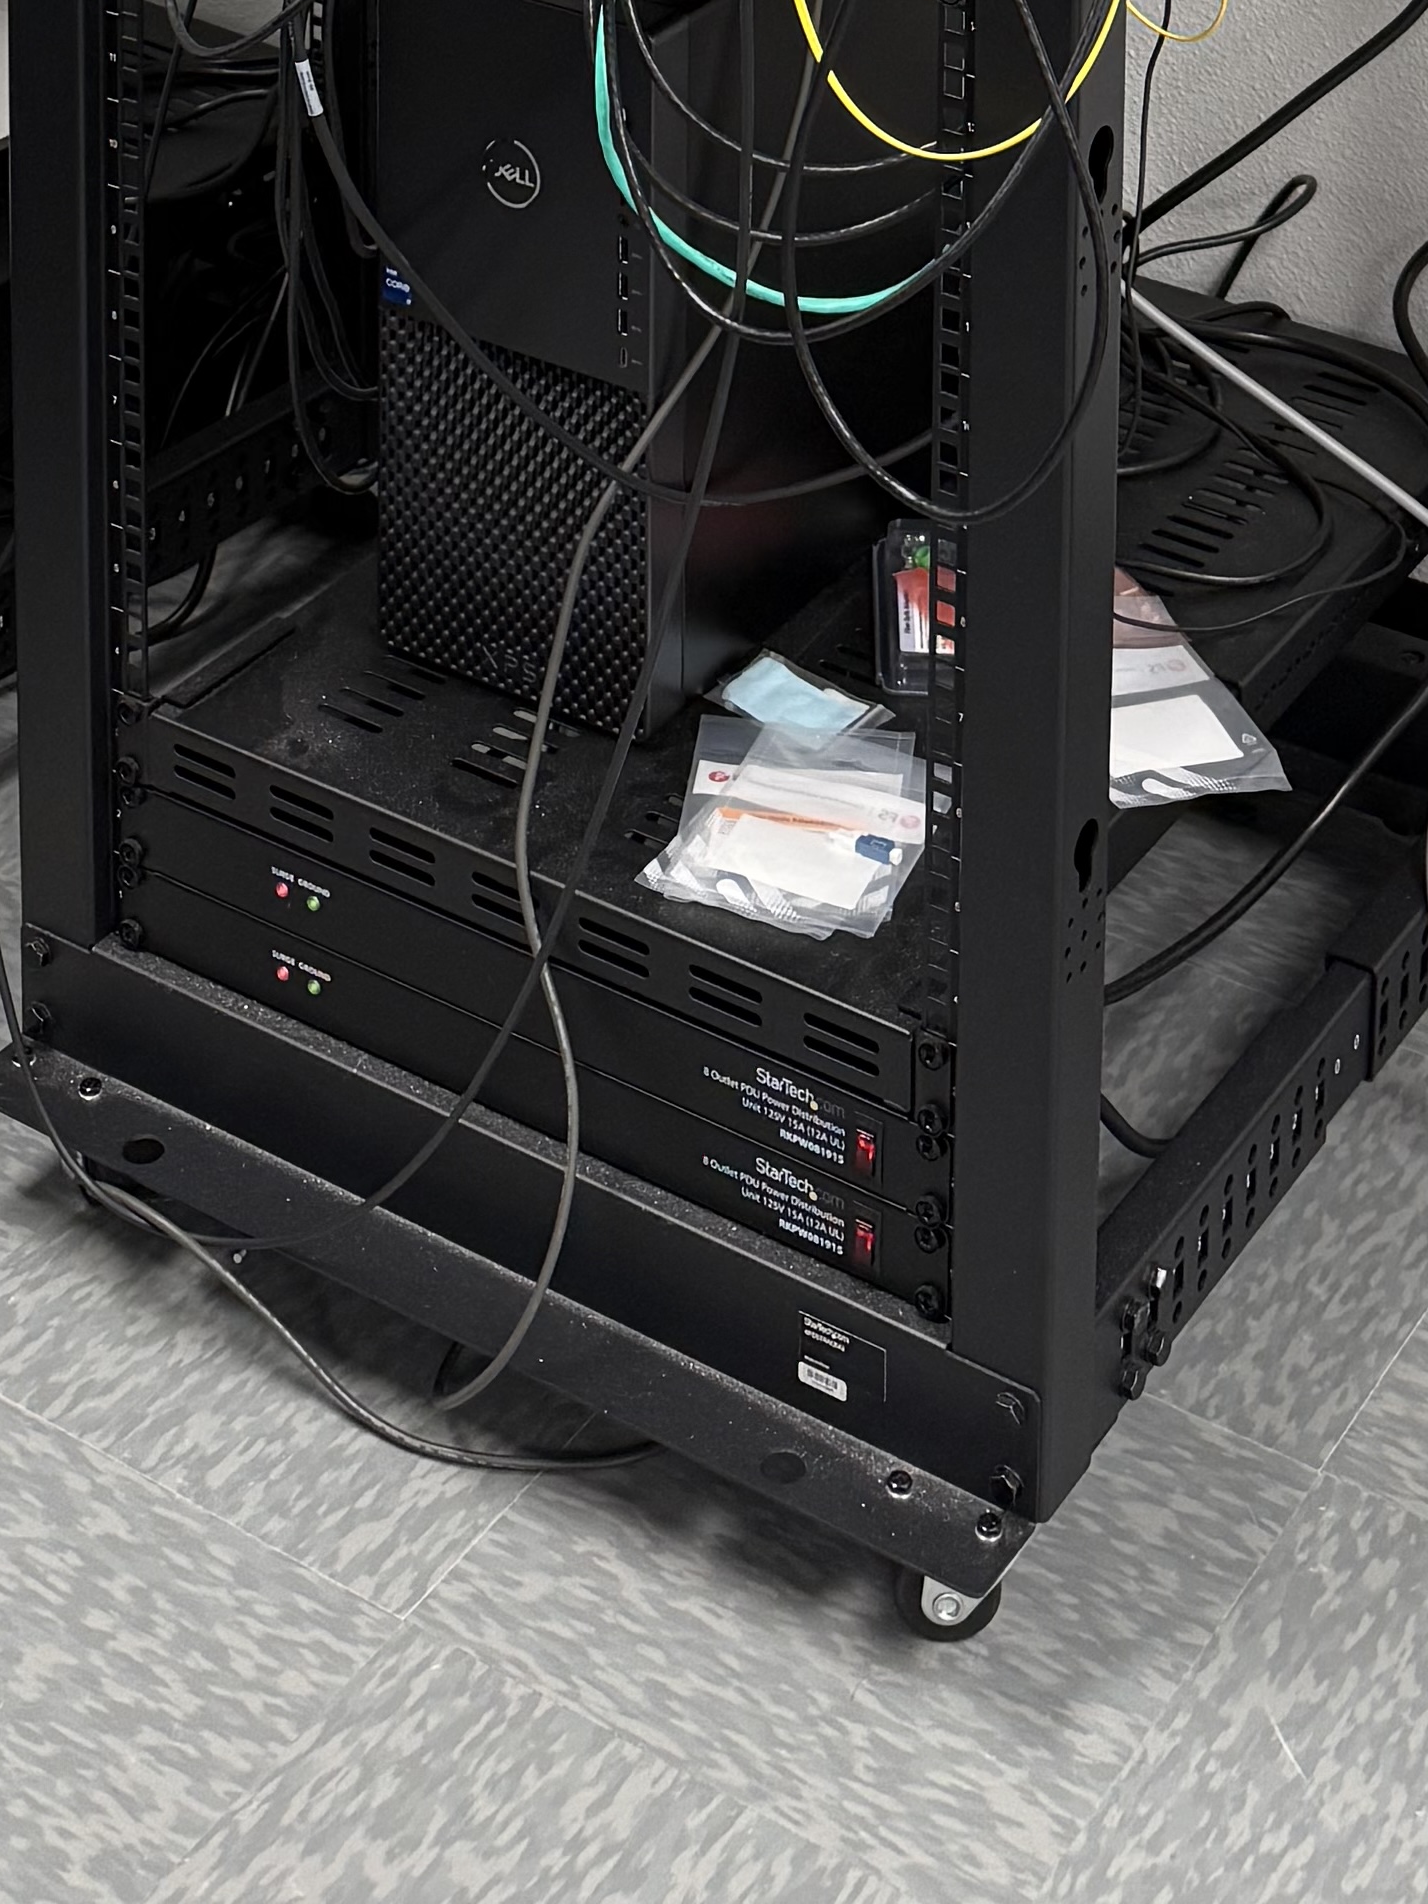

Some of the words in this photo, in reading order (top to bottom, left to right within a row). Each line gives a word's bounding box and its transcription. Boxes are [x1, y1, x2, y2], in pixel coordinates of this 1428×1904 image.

[711, 1071, 738, 1090] Outlet
[741, 1082, 760, 1099] PDU
[762, 1092, 790, 1112] Power
[791, 1105, 845, 1136] Distribution
[742, 1097, 761, 1114] Unit
[763, 1107, 786, 1123] 125V
[788, 1117, 805, 1132] 15A
[830, 1134, 845, 1151] UL)
[710, 1161, 738, 1180] Outlet
[740, 1172, 760, 1189] PDU
[761, 1182, 789, 1202] Power
[790, 1195, 844, 1227] Distribution
[741, 1187, 760, 1204] Unit
[763, 1196, 785, 1213] 125V
[787, 1207, 804, 1222] 15A
[829, 1224, 844, 1241] UL)
